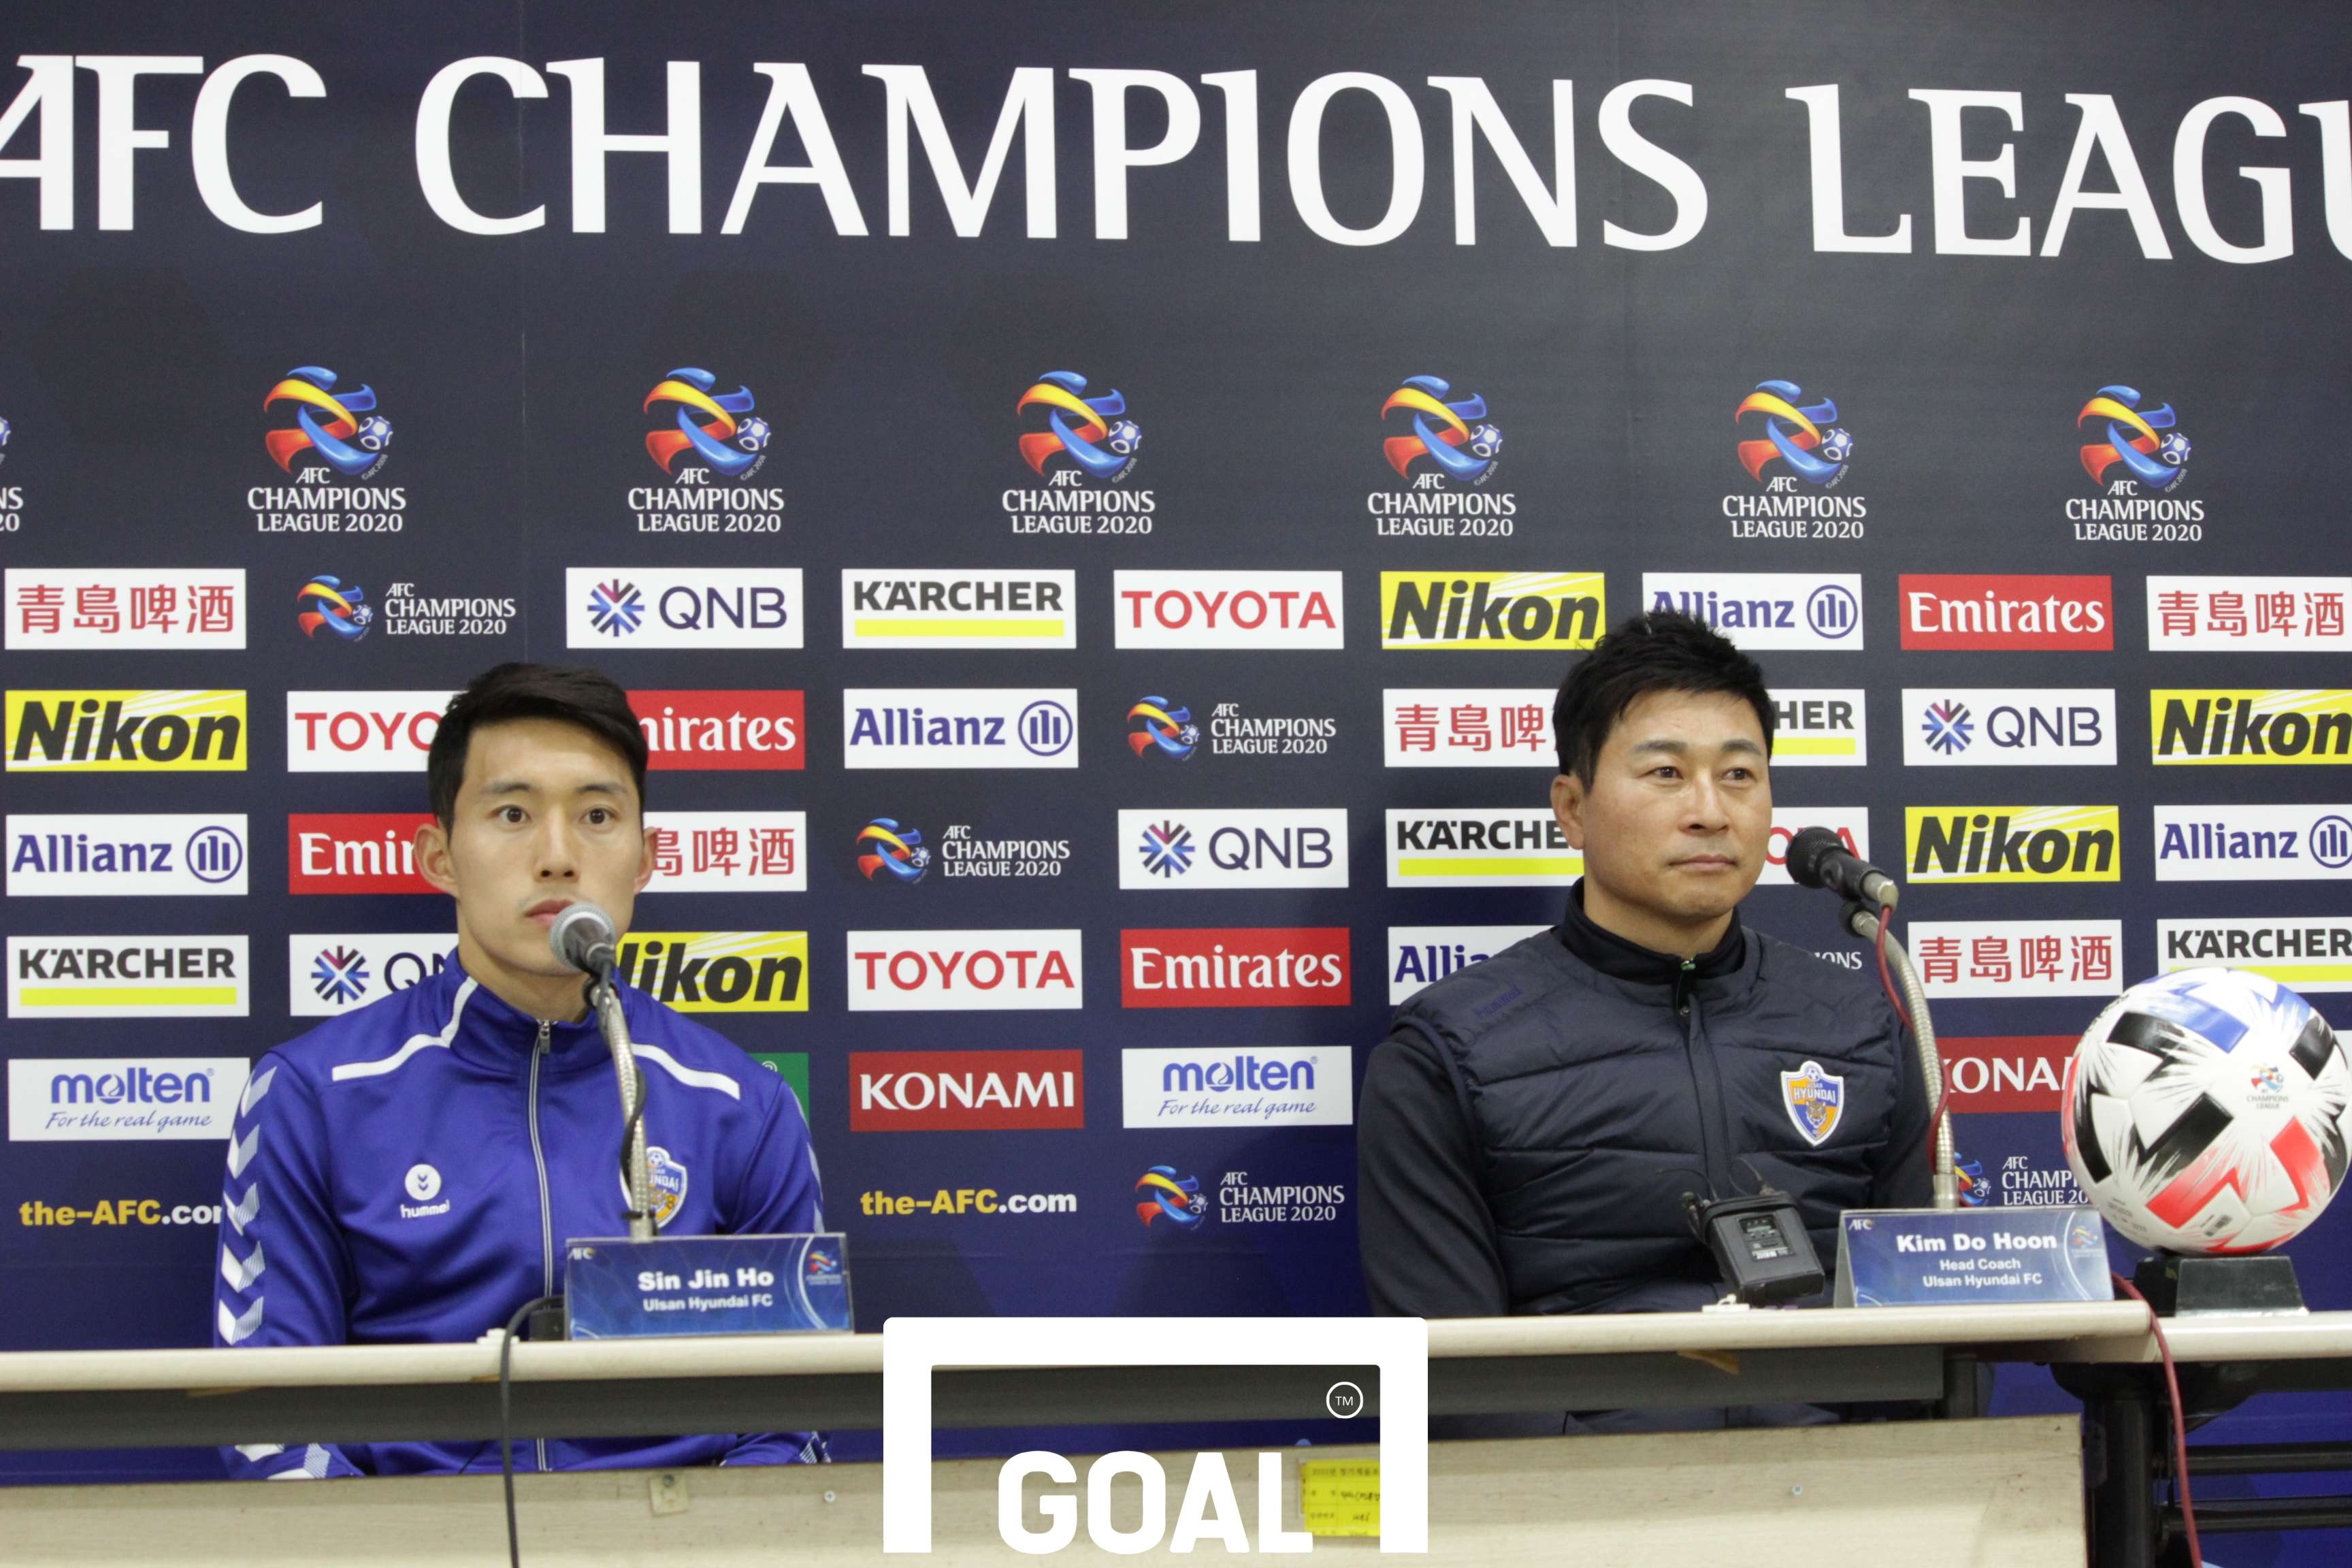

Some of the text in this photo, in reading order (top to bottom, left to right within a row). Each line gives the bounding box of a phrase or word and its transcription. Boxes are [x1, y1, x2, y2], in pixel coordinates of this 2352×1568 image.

[0, 53, 327, 235] AFC
[415, 56, 1708, 251] CHAMPIONS
[296, 468, 331, 484] AFC
[675, 468, 710, 485] AFC
[1048, 470, 1083, 487] AFC
[1412, 473, 1445, 489] AFC
[1766, 476, 1797, 492] AFC
[248, 487, 406, 510] CHAMPIONS
[2108, 480, 2138, 495] AFC
[627, 488, 785, 510] CHAMPIONS
[1002, 489, 1156, 512] CHAMPIONS
[1367, 493, 1516, 515] CHAMPIONS
[1722, 495, 1867, 518] CHAMPIONS
[2065, 499, 2204, 521] CHAMPIONS
[257, 513, 402, 532] LEAGUE 2020
[637, 514, 781, 532] LEAGUE 2020
[1011, 516, 1153, 534] LEAGUE 2020
[1377, 519, 1514, 536] LEAGUE 2020
[1731, 521, 1864, 538] LEAGUE 2020
[2074, 523, 2202, 542] LEAGUE 2020
[385, 583, 414, 598] AFC
[854, 581, 1064, 611] KÄRCHER
[16, 584, 235, 634] 青島啤酒
[385, 598, 516, 618] CHAMPIONS
[659, 585, 787, 631] QNB
[1121, 589, 1336, 630] TOYOTA
[1388, 579, 1600, 640] Nikon
[1654, 591, 1795, 627] Allianz
[1908, 590, 2105, 633] Emirates
[2157, 590, 2344, 637] 青島啤酒
[387, 619, 456, 635] LEAGUE
[459, 619, 507, 635] 2020
[1211, 703, 1239, 717] AFC
[12, 698, 241, 762] Nikon
[295, 711, 443, 751] TOYO
[639, 706, 796, 751] irates
[850, 708, 1005, 747] Allianz
[1211, 718, 1336, 738] CHAMPIONS
[1394, 704, 1552, 751] 青島啤
[1987, 706, 2102, 748] QNB
[2158, 697, 2352, 756] Nikon
[1211, 738, 1279, 754] LEAGUE
[1281, 738, 1327, 754] 2020
[943, 825, 970, 839] AFC
[1397, 820, 1569, 850] KÄRCHE
[2159, 823, 2298, 860] Allianz
[12, 834, 172, 872] Allianz
[299, 830, 414, 875] Emir
[653, 828, 795, 876] 島啤酒
[942, 840, 1071, 860] CHAMPIONS
[1209, 827, 1333, 870] QNB
[1912, 814, 2114, 875] Nikon
[943, 861, 1011, 877] LEAGUE
[1015, 861, 1061, 877] 2020
[2168, 929, 2352, 959] KÄRCHER
[19, 948, 235, 979] KÄRCHER
[1130, 945, 1342, 990] Emirates
[1394, 945, 1490, 982] Alli
[1919, 935, 2112, 983] 青島啤酒
[855, 950, 1075, 991] TOYOTA
[1163, 1056, 1314, 1092] molten
[1943, 1056, 2074, 1094] ONA
[51, 1067, 210, 1104] molten
[860, 1071, 1074, 1111] KONAMI
[1794, 1088, 1836, 1104] HYUNDAI
[1158, 1097, 1316, 1120] For the real game
[46, 1110, 212, 1132] For the real game
[2002, 1156, 2028, 1170] AFC
[1221, 1171, 1247, 1186] AFC
[2002, 1171, 2078, 1189] CHAMPI
[860, 1189, 1077, 1216] the-AFC.com
[1220, 1185, 1345, 1206] CHAMPIONS
[2003, 1190, 2089, 1205] LEAGUE 20
[400, 1199, 451, 1218] hummel
[1221, 1207, 1287, 1223] LEAGUE
[1290, 1205, 1336, 1222] 2020
[1848, 1219, 1873, 1230] AFC
[568, 1247, 595, 1260] AFC
[1896, 1232, 2057, 1253] Kim Do Hoon
[1940, 1258, 2021, 1271] Head Coach
[638, 1267, 774, 1292] Sin Jin Ho
[1923, 1273, 2042, 1289] Ulsan Hyundai FC
[643, 1294, 773, 1313] Ulsan Hyundai FC
